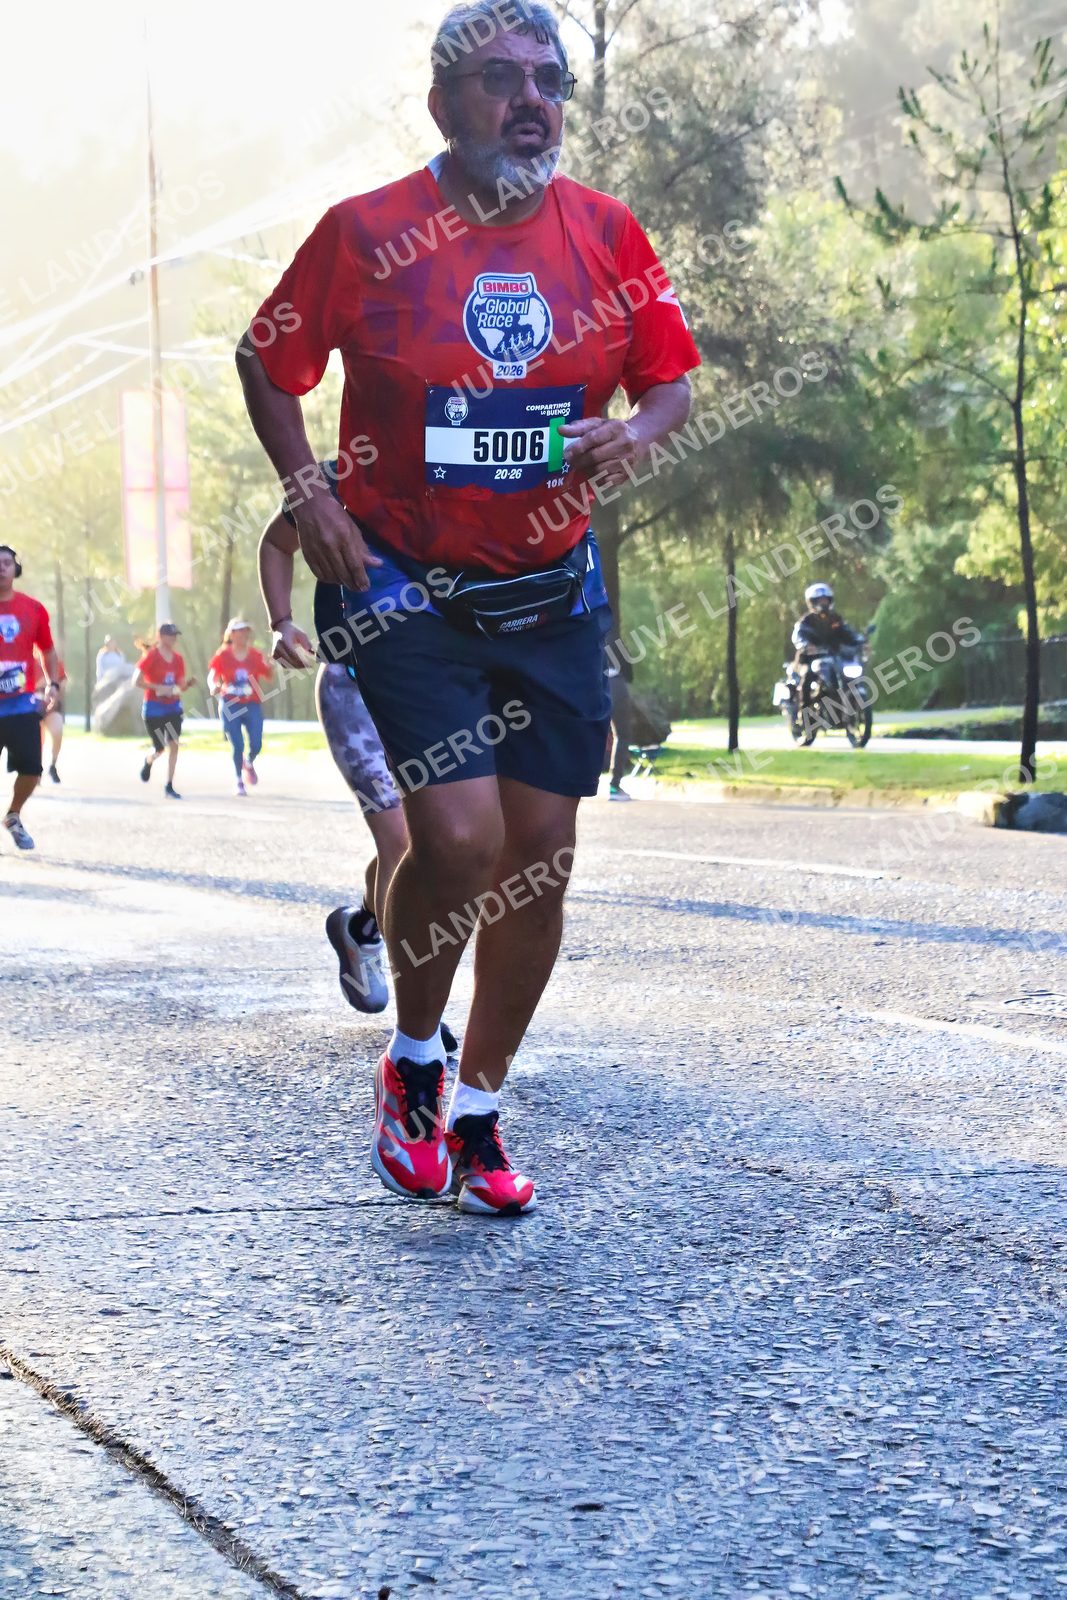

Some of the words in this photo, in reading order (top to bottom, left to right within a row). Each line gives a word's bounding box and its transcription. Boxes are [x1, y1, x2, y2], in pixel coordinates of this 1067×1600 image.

[483, 282, 528, 293] BIMBO
[486, 299, 530, 315] Global
[478, 312, 513, 327] Race
[495, 365, 524, 377] 2026
[526, 402, 571, 411] COMPARTIMOS
[474, 430, 544, 463] 5006
[546, 477, 564, 489] 10K
[499, 614, 538, 628] CARRERA
